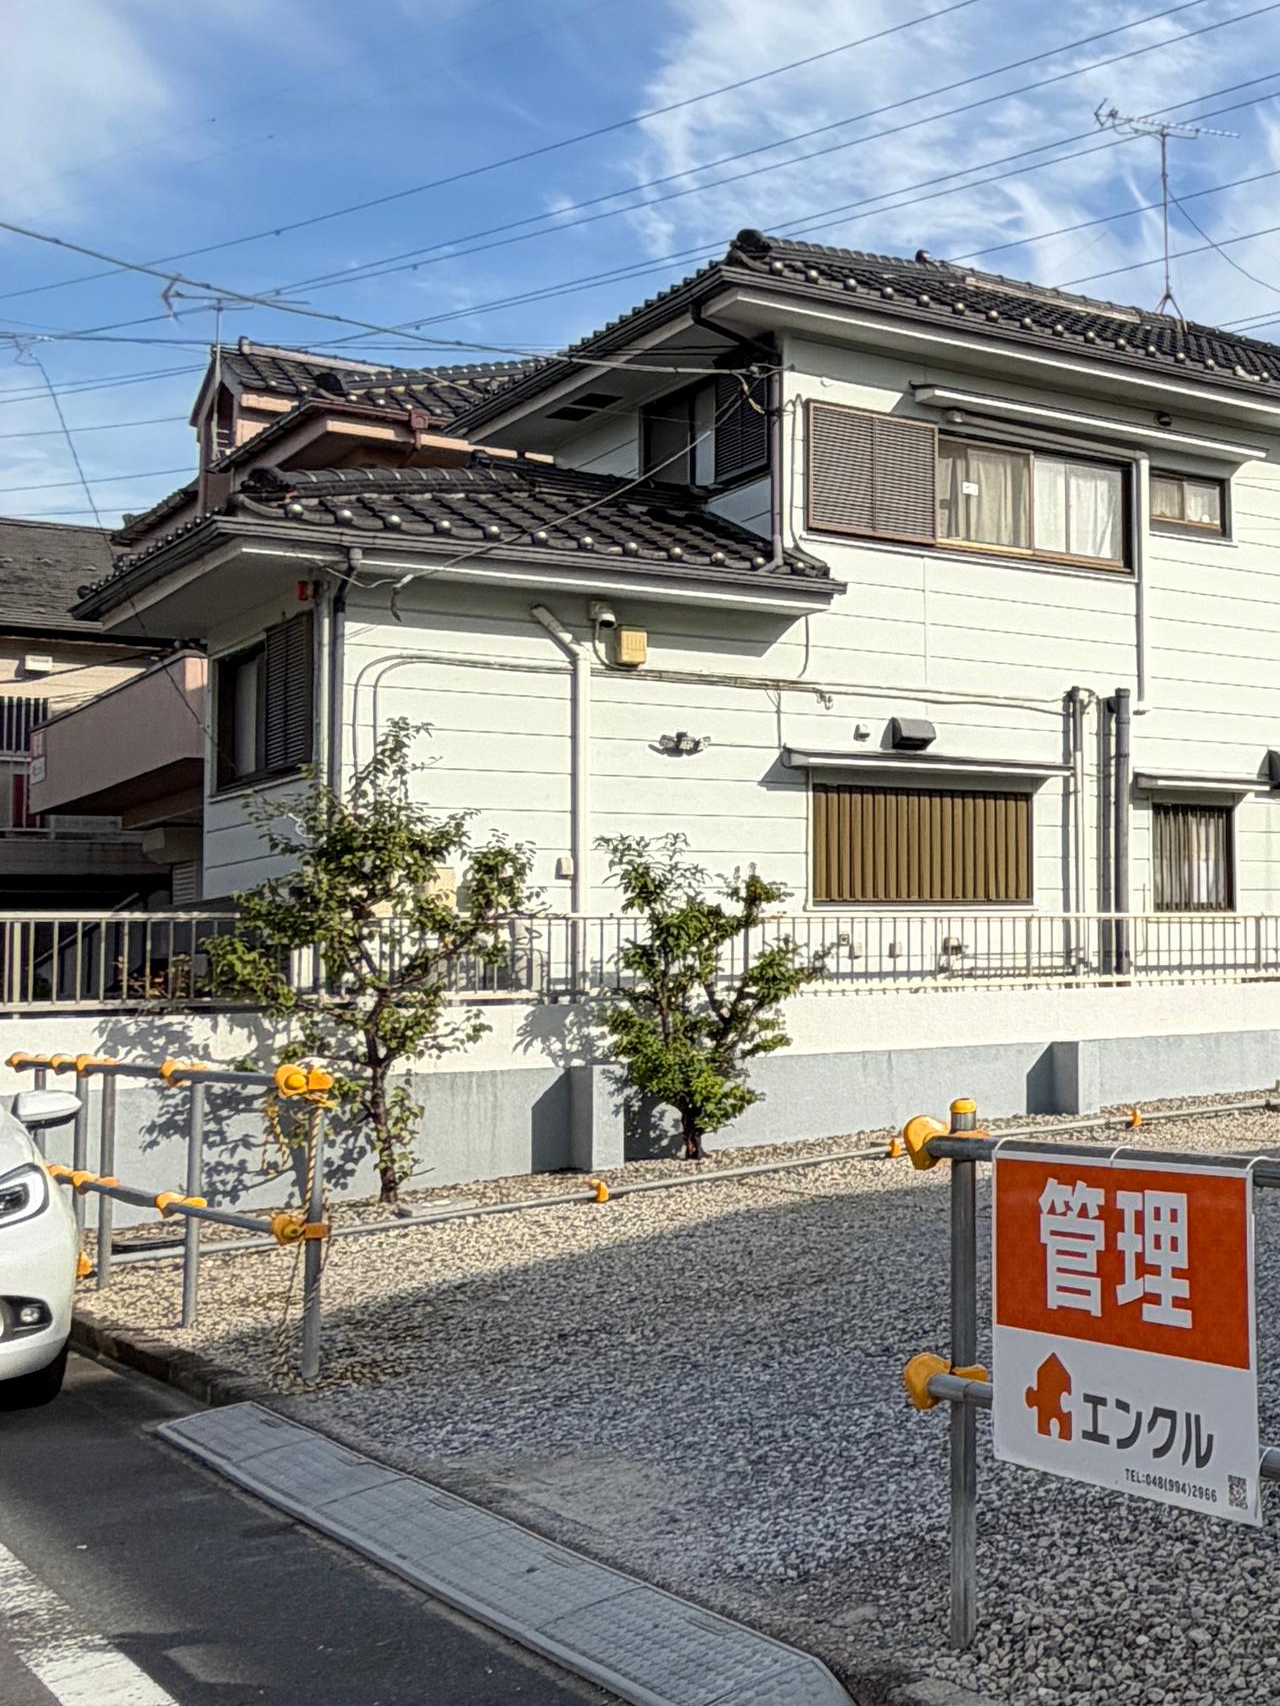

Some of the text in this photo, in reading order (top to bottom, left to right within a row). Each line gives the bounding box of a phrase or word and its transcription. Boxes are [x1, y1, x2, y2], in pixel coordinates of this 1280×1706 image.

[1038, 1177, 1193, 1329] 管理
[1081, 1392, 1215, 1470] エンクル
